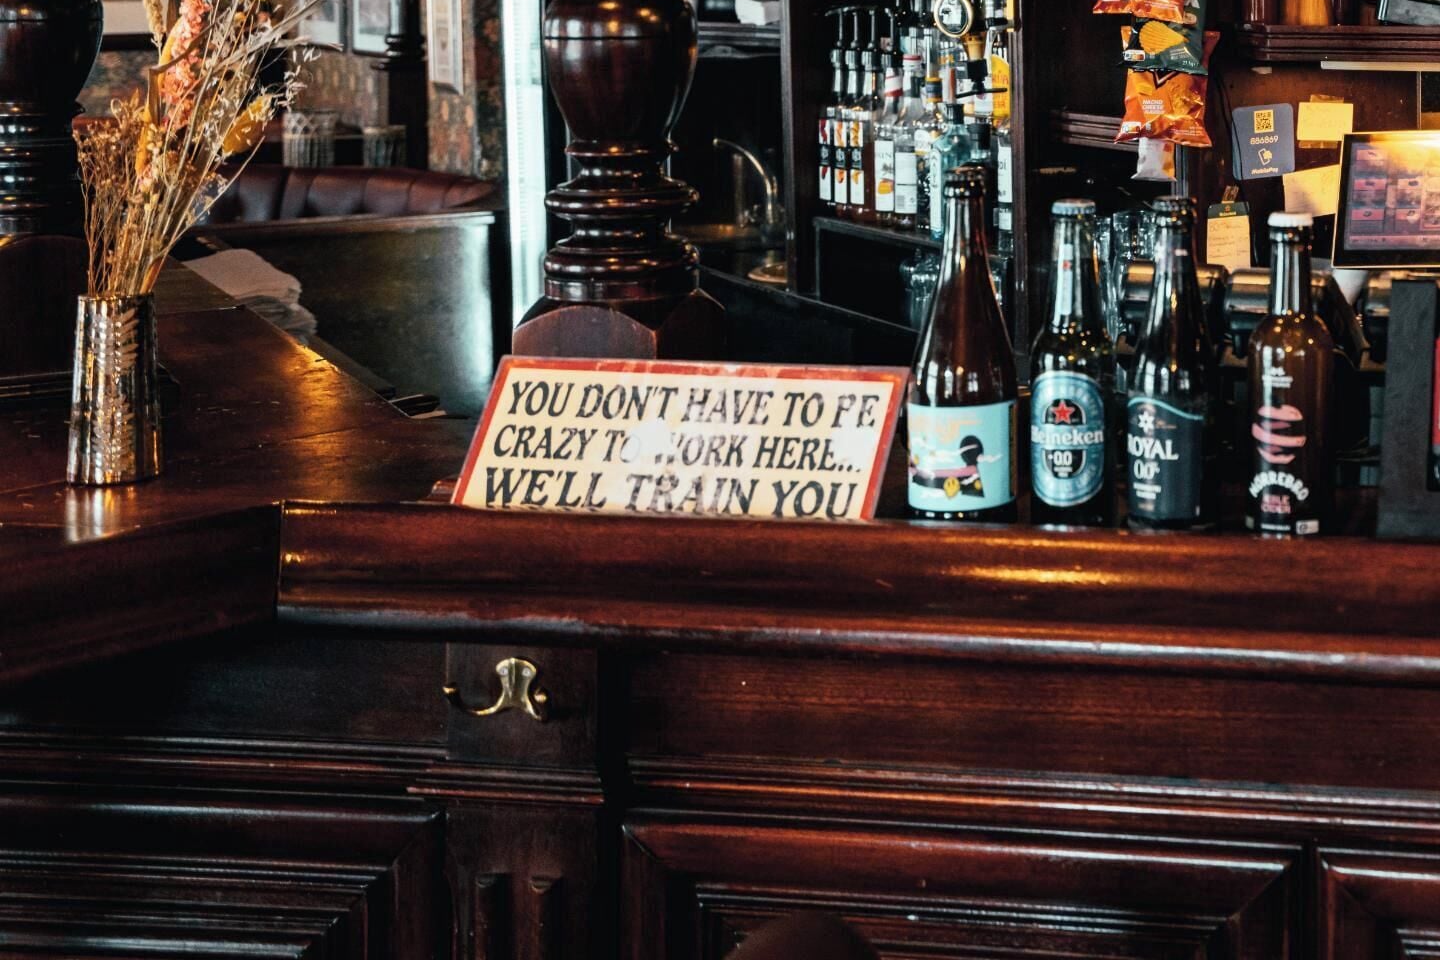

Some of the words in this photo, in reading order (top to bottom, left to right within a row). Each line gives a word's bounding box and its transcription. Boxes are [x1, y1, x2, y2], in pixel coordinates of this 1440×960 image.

[507, 380, 575, 417] YOU
[575, 383, 679, 421] DON'T
[680, 387, 775, 427] HAVE
[782, 391, 825, 428] TO
[493, 424, 598, 462] CRAZY
[602, 429, 641, 464] TO
[485, 466, 608, 509] WE'LL
[624, 472, 759, 515] TRAIN
[772, 479, 858, 519] YOU
